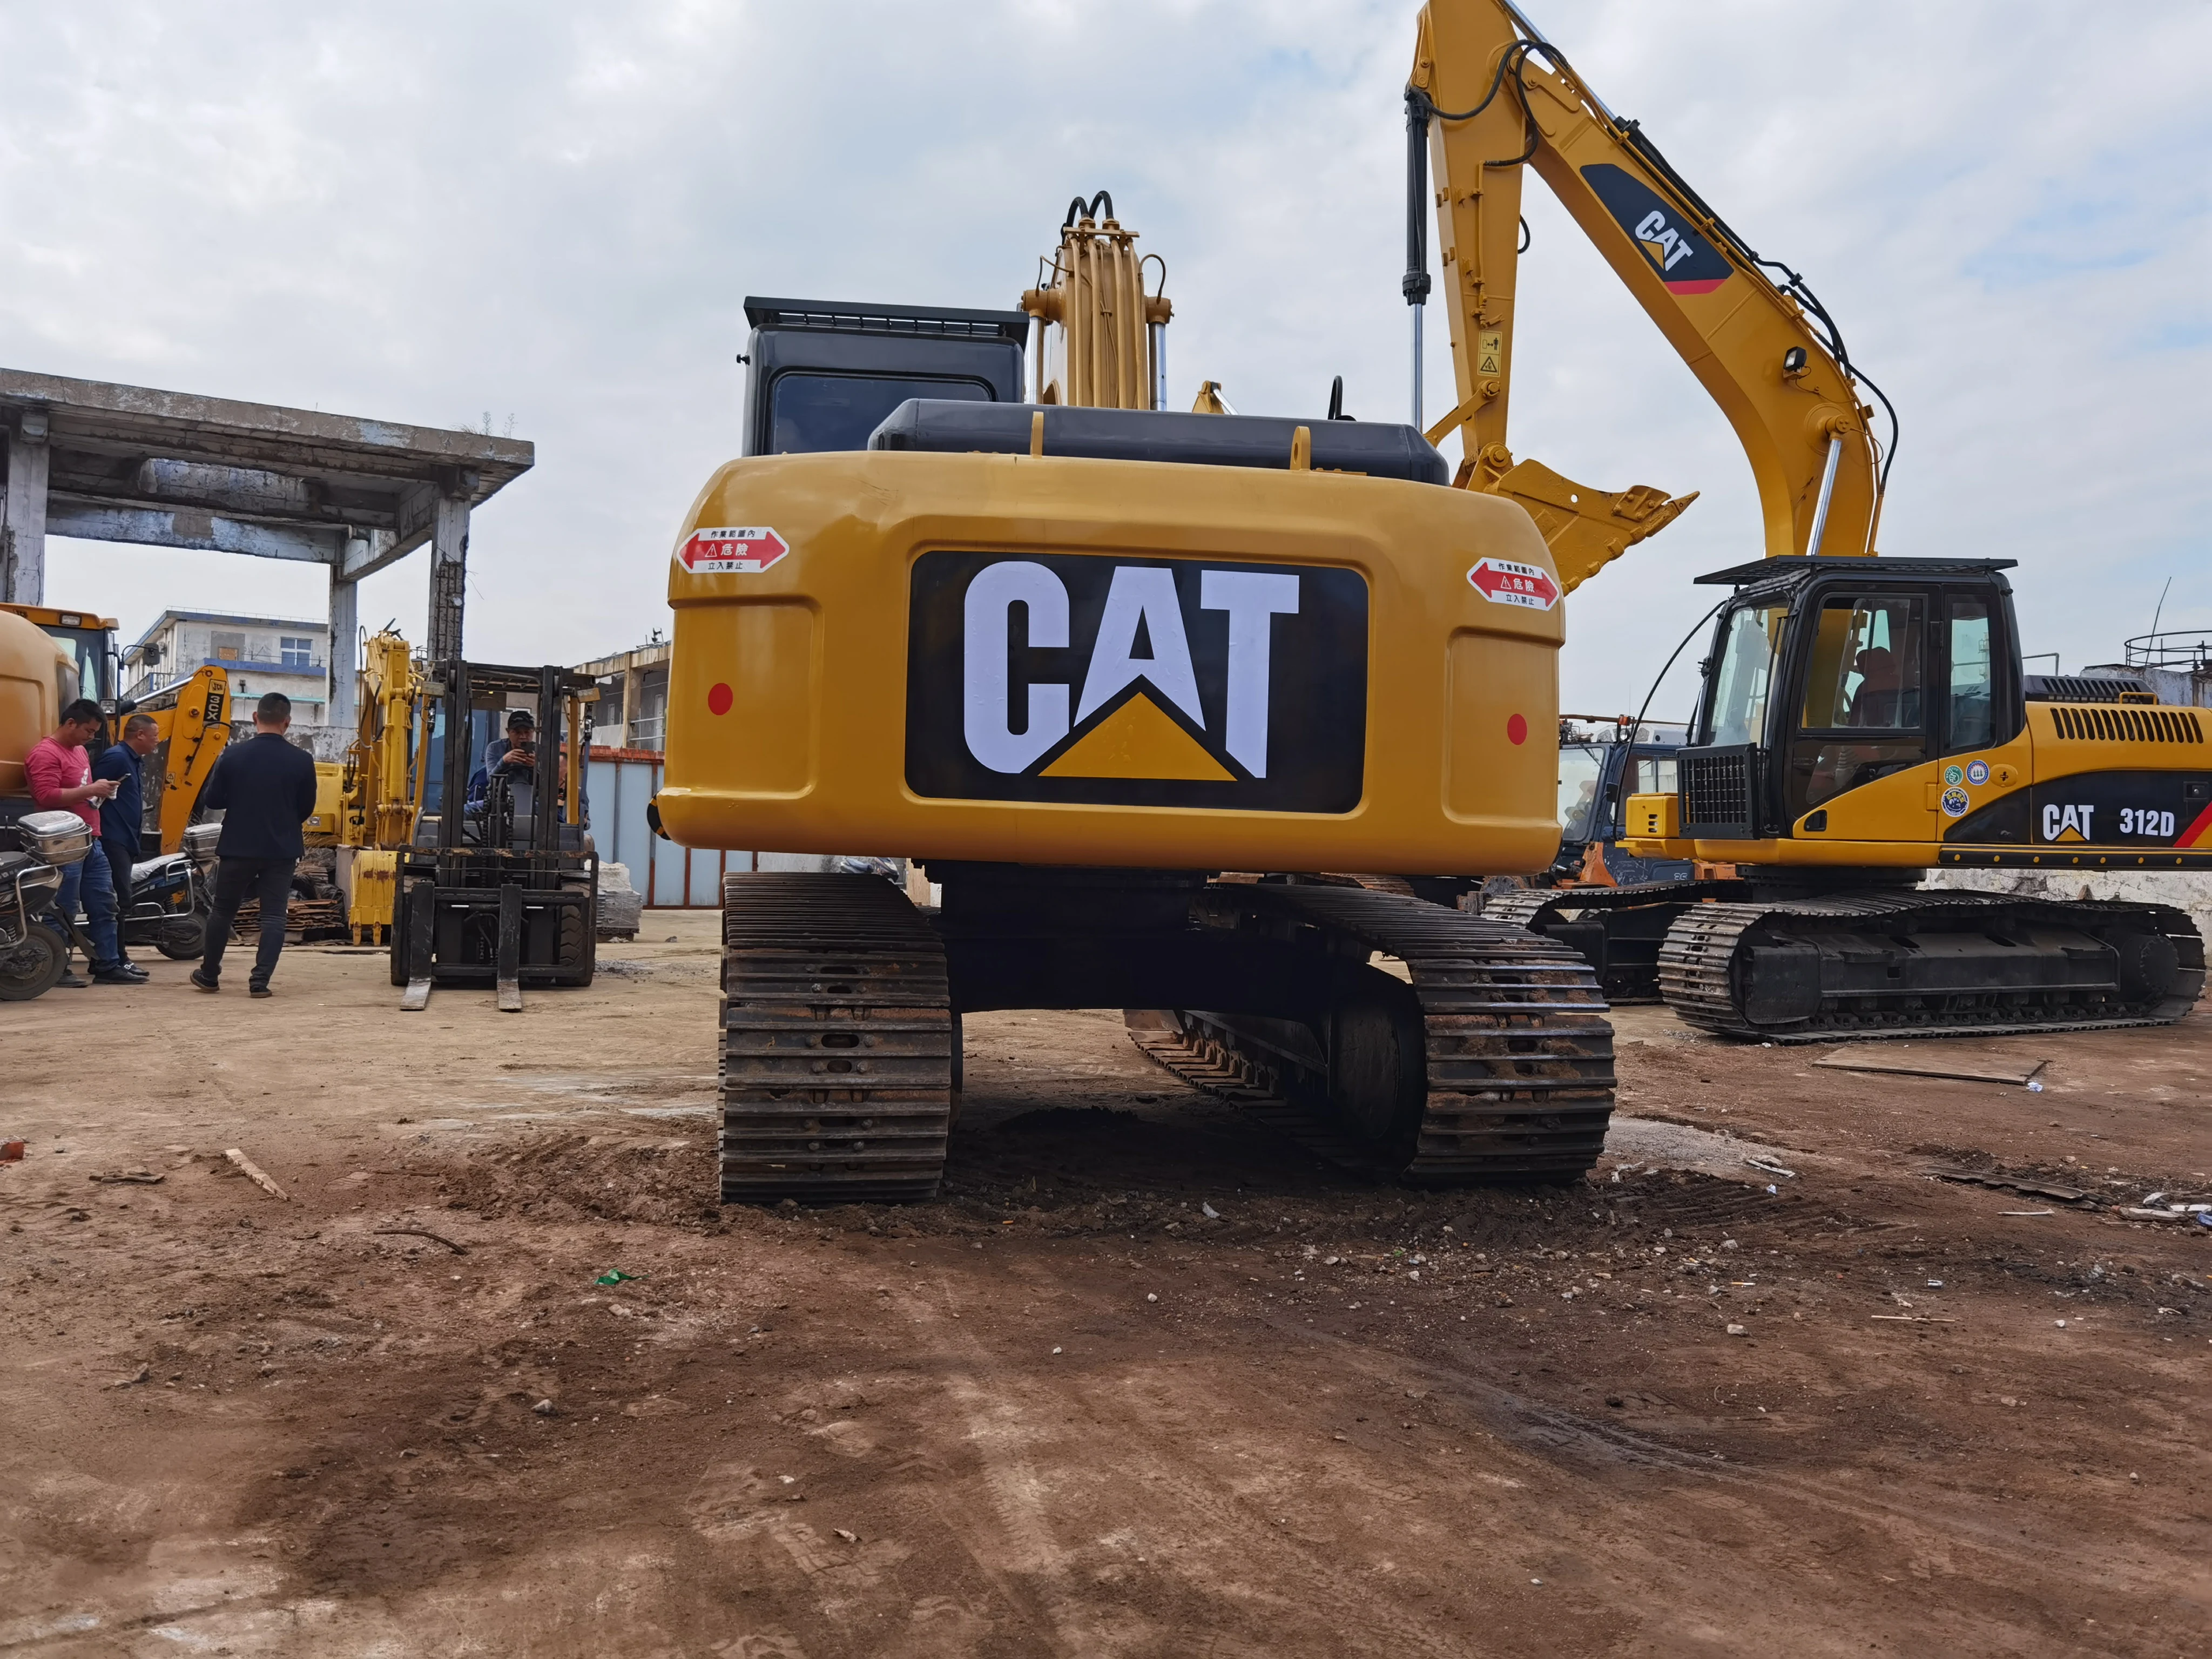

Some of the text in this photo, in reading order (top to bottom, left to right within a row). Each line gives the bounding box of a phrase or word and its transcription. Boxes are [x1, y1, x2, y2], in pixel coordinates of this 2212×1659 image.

[1635, 211, 1694, 271] CAT
[720, 543, 749, 556] 危險
[708, 561, 743, 570] 立入禁止
[1506, 594, 1534, 605] 立入禁止
[965, 561, 1299, 779] CAT
[206, 695, 220, 720] 3CX
[2042, 804, 2094, 841] CAT
[2119, 808, 2175, 837] 312D
